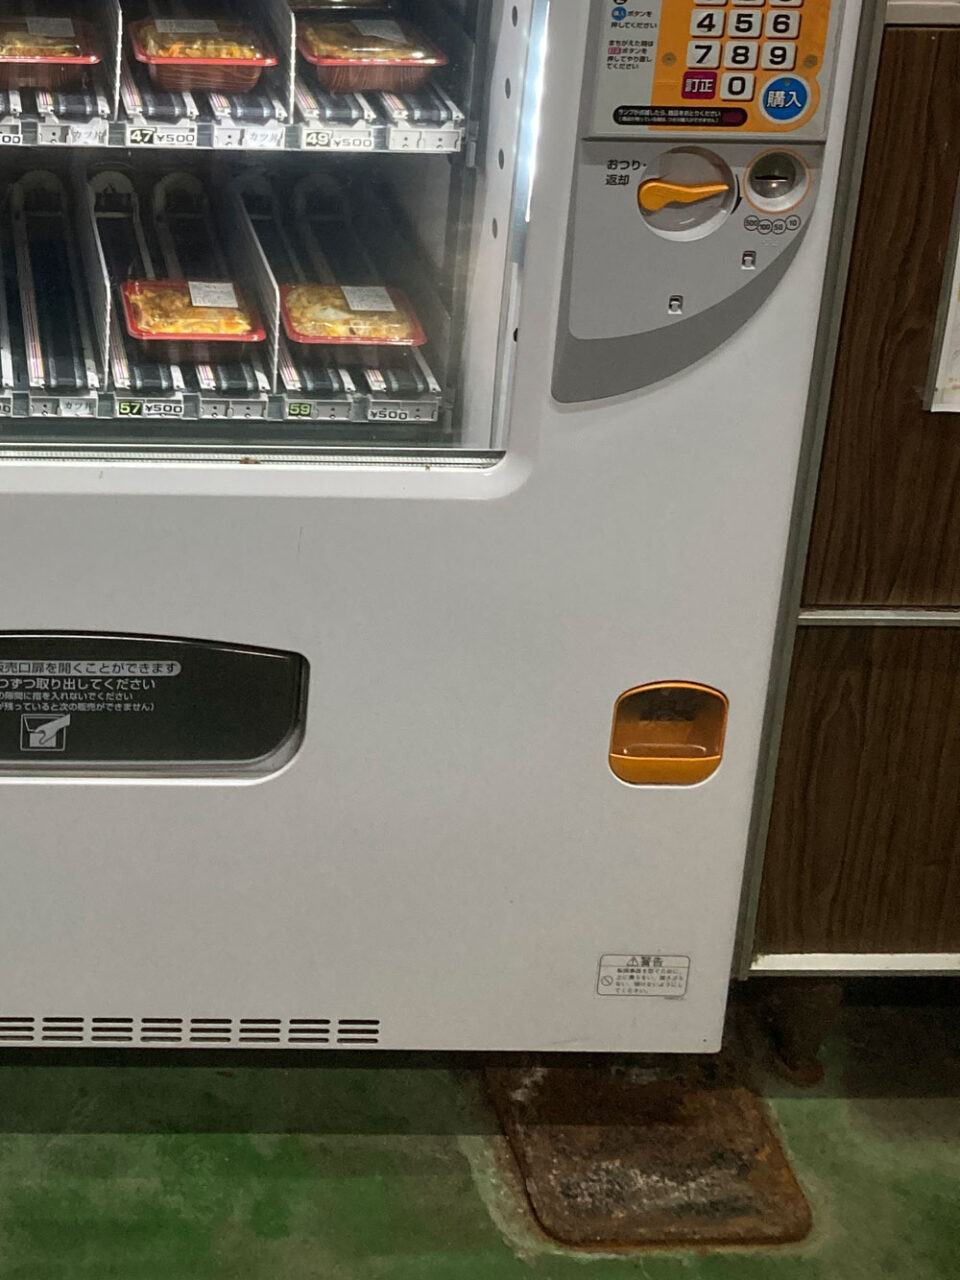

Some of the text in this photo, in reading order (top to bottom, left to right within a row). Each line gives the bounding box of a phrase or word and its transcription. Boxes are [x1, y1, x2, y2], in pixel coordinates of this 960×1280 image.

[696, 13, 790, 33] 4 5 6
[694, 45, 787, 65] 7 8 9
[685, 79, 714, 92] 訂正
[728, 76, 746, 95] 0
[767, 91, 802, 108] 購入
[131, 129, 195, 142] 47 ¥500
[306, 133, 372, 147] 49 ¥500
[605, 175, 629, 186] 返却
[119, 403, 183, 414] 57 ¥500
[290, 404, 311, 415] 59
[371, 410, 408, 420] ¥500
